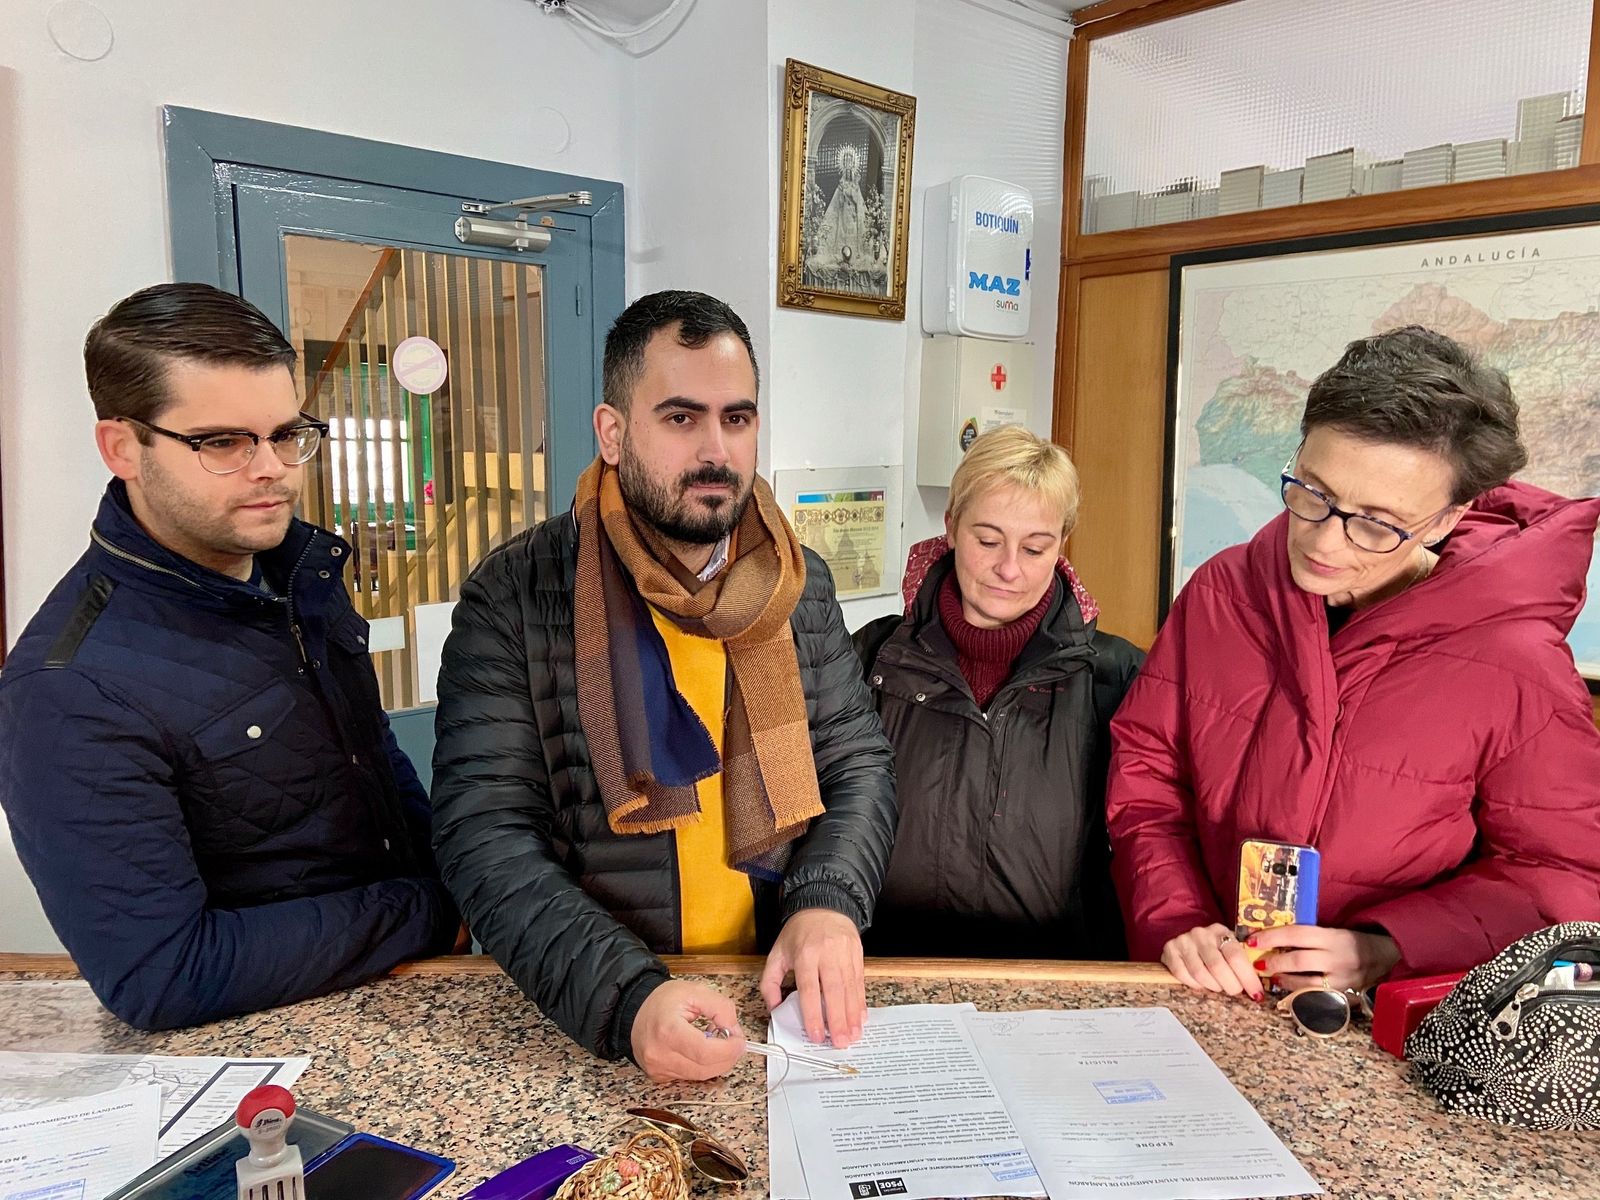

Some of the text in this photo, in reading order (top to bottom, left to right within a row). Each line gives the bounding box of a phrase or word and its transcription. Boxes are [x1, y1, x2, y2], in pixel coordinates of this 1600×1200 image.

[976, 211, 1019, 234] BOTIQUÍN
[1420, 246, 1540, 268] ANDALUCÍA
[969, 272, 1020, 296] MAZ
[996, 300, 1018, 311] suma
[13, 1114, 78, 1129] AYUNTAMIENTO
[886, 1166, 928, 1174] AYUNTAMIENTO
[878, 1181, 903, 1189] PSOE
[1120, 1178, 1178, 1186] AYUNTAMIENTO
